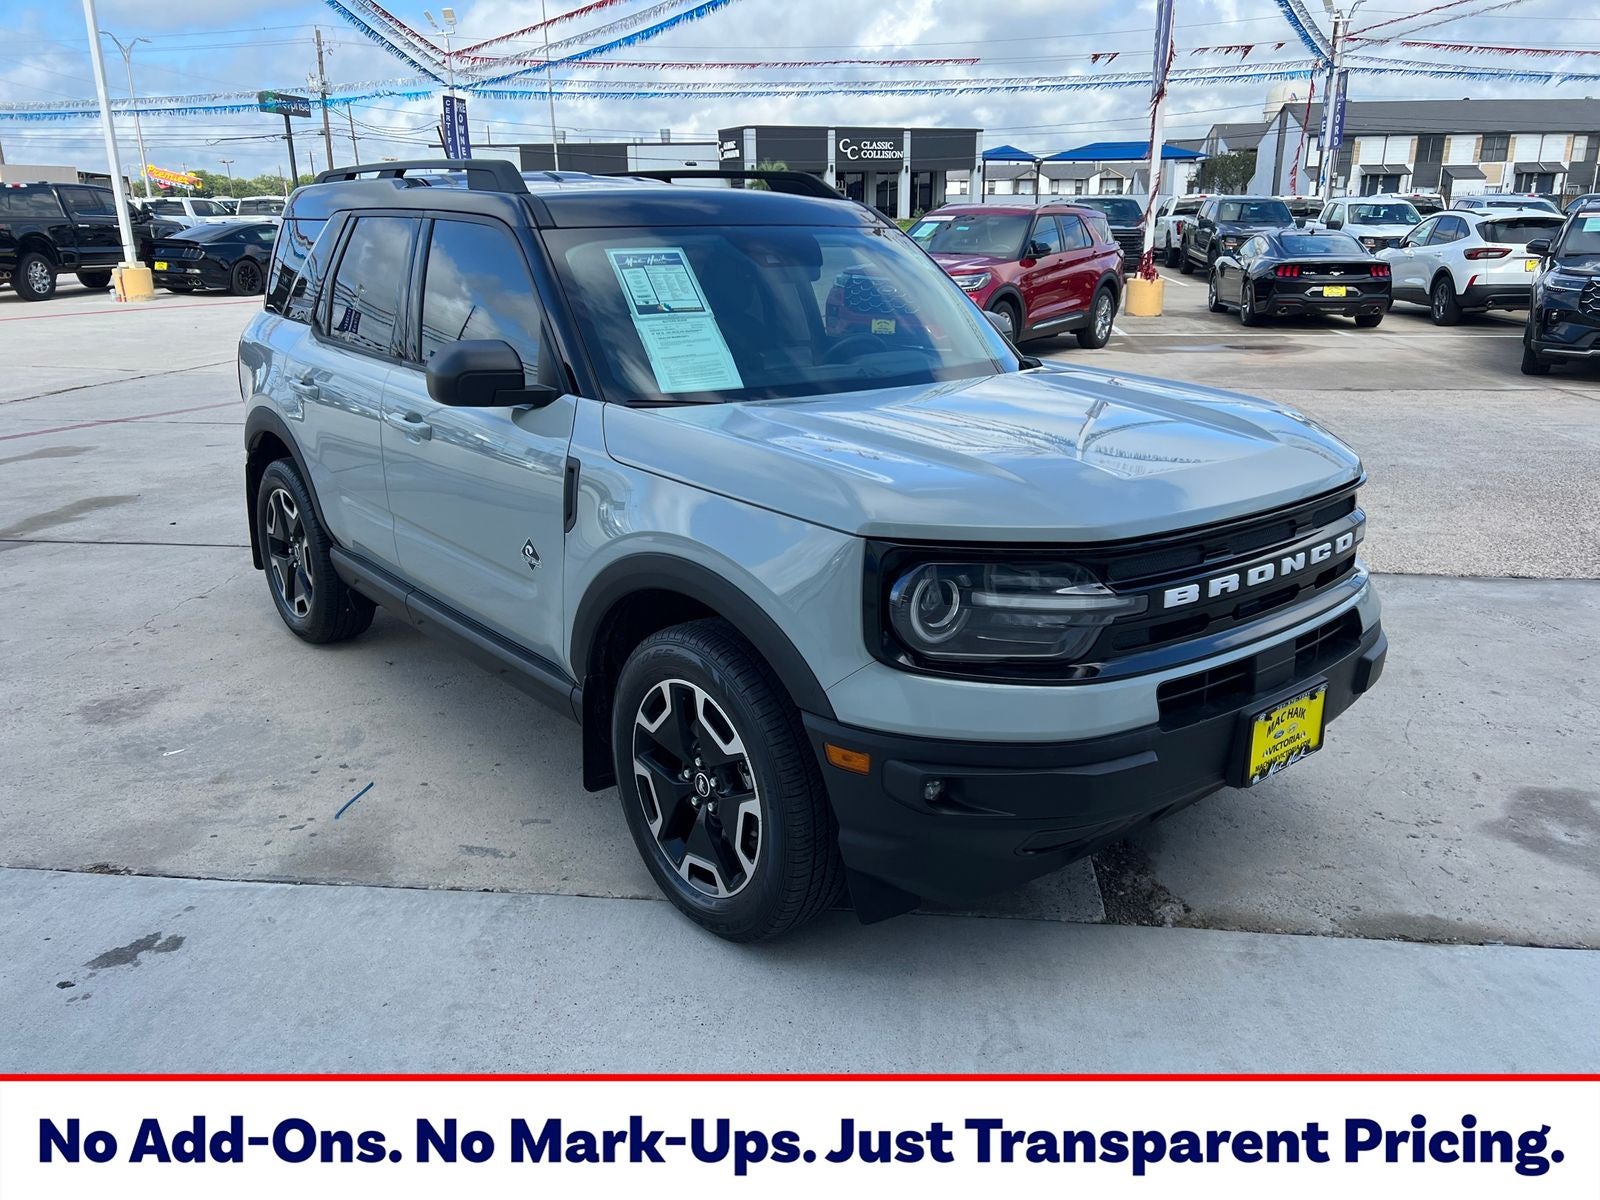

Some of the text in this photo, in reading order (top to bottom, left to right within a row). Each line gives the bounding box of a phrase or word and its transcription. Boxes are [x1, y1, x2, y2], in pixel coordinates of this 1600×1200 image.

[445, 99, 455, 159] CERTIFIE
[458, 114, 467, 160] OWNE
[1333, 103, 1341, 146] FORD
[861, 141, 894, 150] CLASSIC
[861, 150, 904, 159] COLLISION
[1164, 532, 1354, 609] BRONCO
[1267, 711, 1287, 738] MAC
[1287, 706, 1306, 721] HAIK
[1268, 734, 1301, 756] VICTORIA
